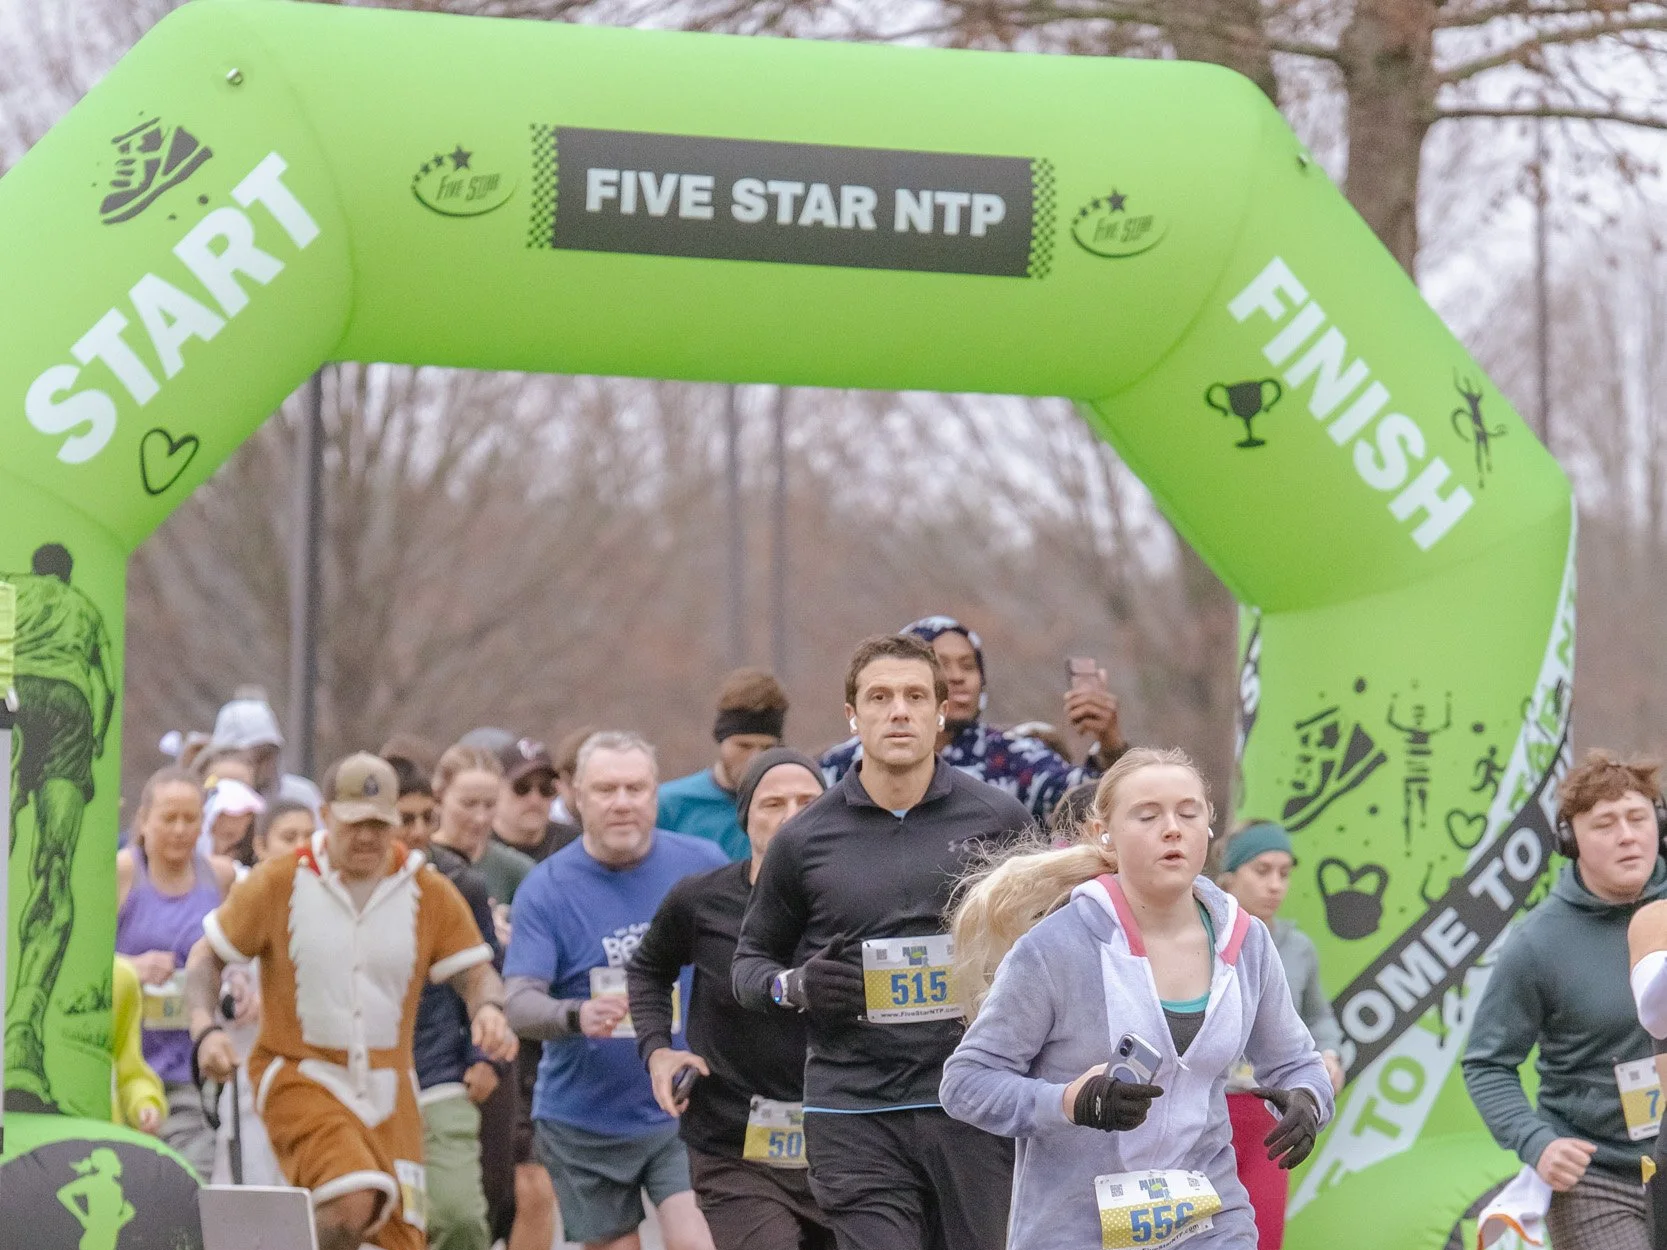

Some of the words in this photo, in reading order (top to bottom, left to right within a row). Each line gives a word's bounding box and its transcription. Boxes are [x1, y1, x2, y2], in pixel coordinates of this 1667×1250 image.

[585, 167, 716, 220] FIVE
[730, 177, 879, 231] STAR
[893, 187, 1007, 237] NTP
[25, 152, 321, 464] START
[1226, 255, 1475, 551] FINISH
[890, 970, 948, 1006] 515
[1340, 906, 1481, 1073] OME
[1468, 827, 1543, 912] TO
[1352, 1055, 1427, 1140] TO
